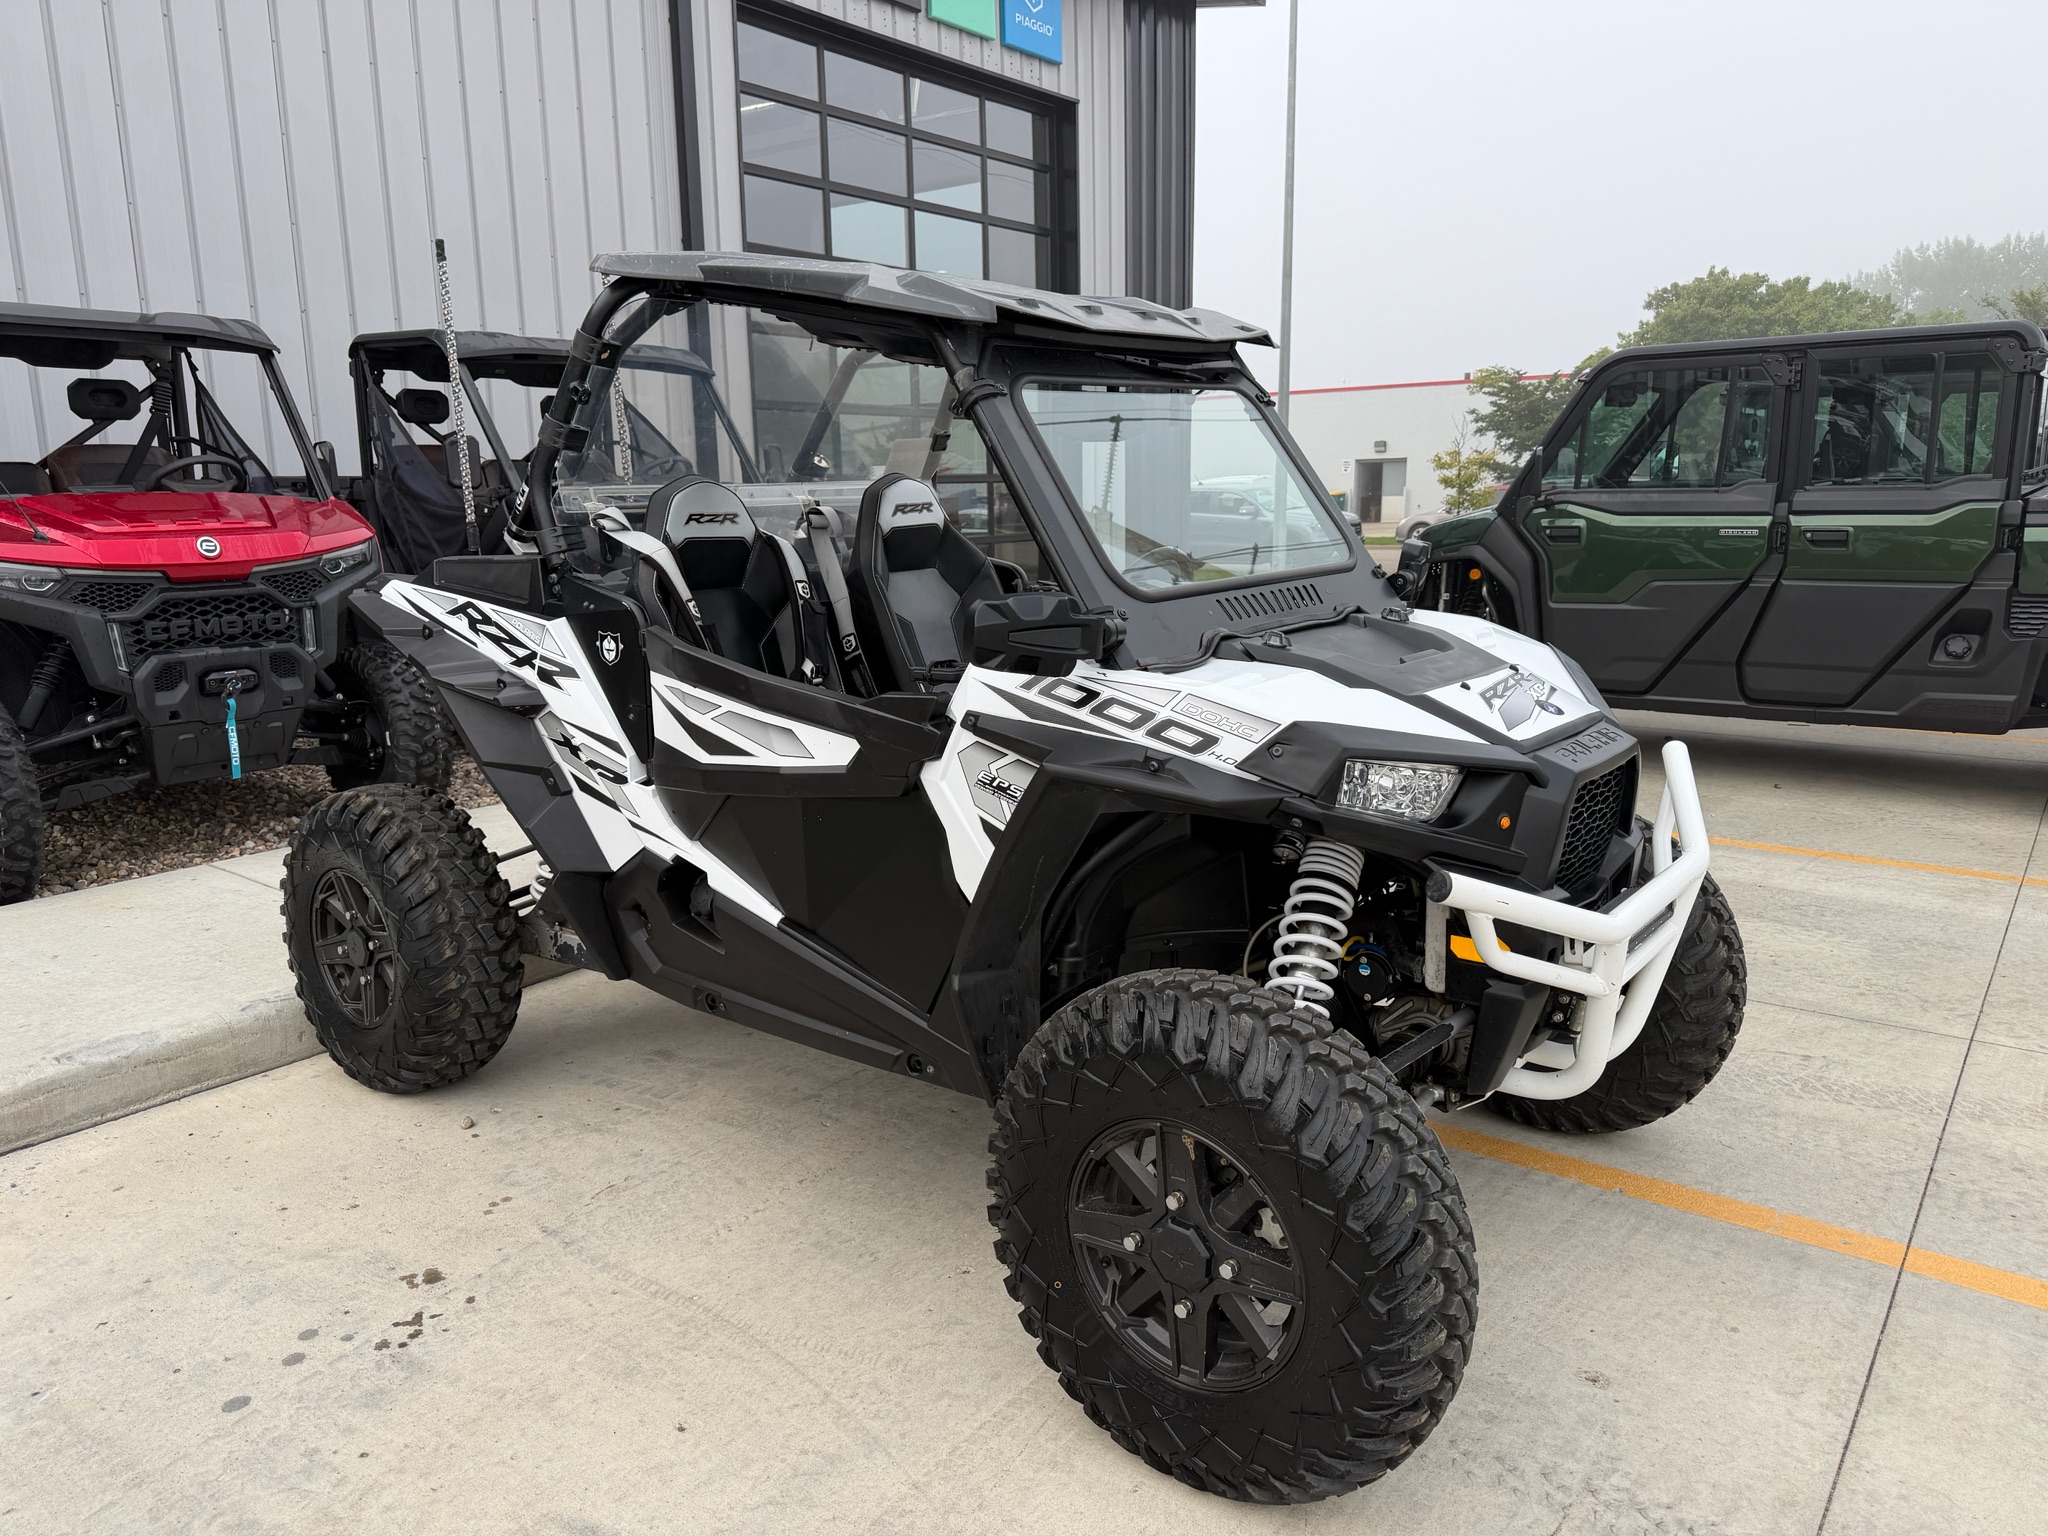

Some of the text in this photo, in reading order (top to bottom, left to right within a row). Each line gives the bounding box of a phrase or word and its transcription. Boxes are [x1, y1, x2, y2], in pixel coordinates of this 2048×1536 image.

[1015, 13, 1053, 37] PIAGGIO
[684, 512, 740, 527] RZR
[892, 501, 934, 518] RZR
[145, 611, 287, 642] CFMOTO
[511, 617, 541, 644] POLARIS
[444, 600, 583, 696] RZR
[1180, 702, 1260, 739] DOHC
[227, 726, 240, 766] CFMOTO
[549, 731, 629, 785] XP
[977, 770, 1026, 798] EPS
